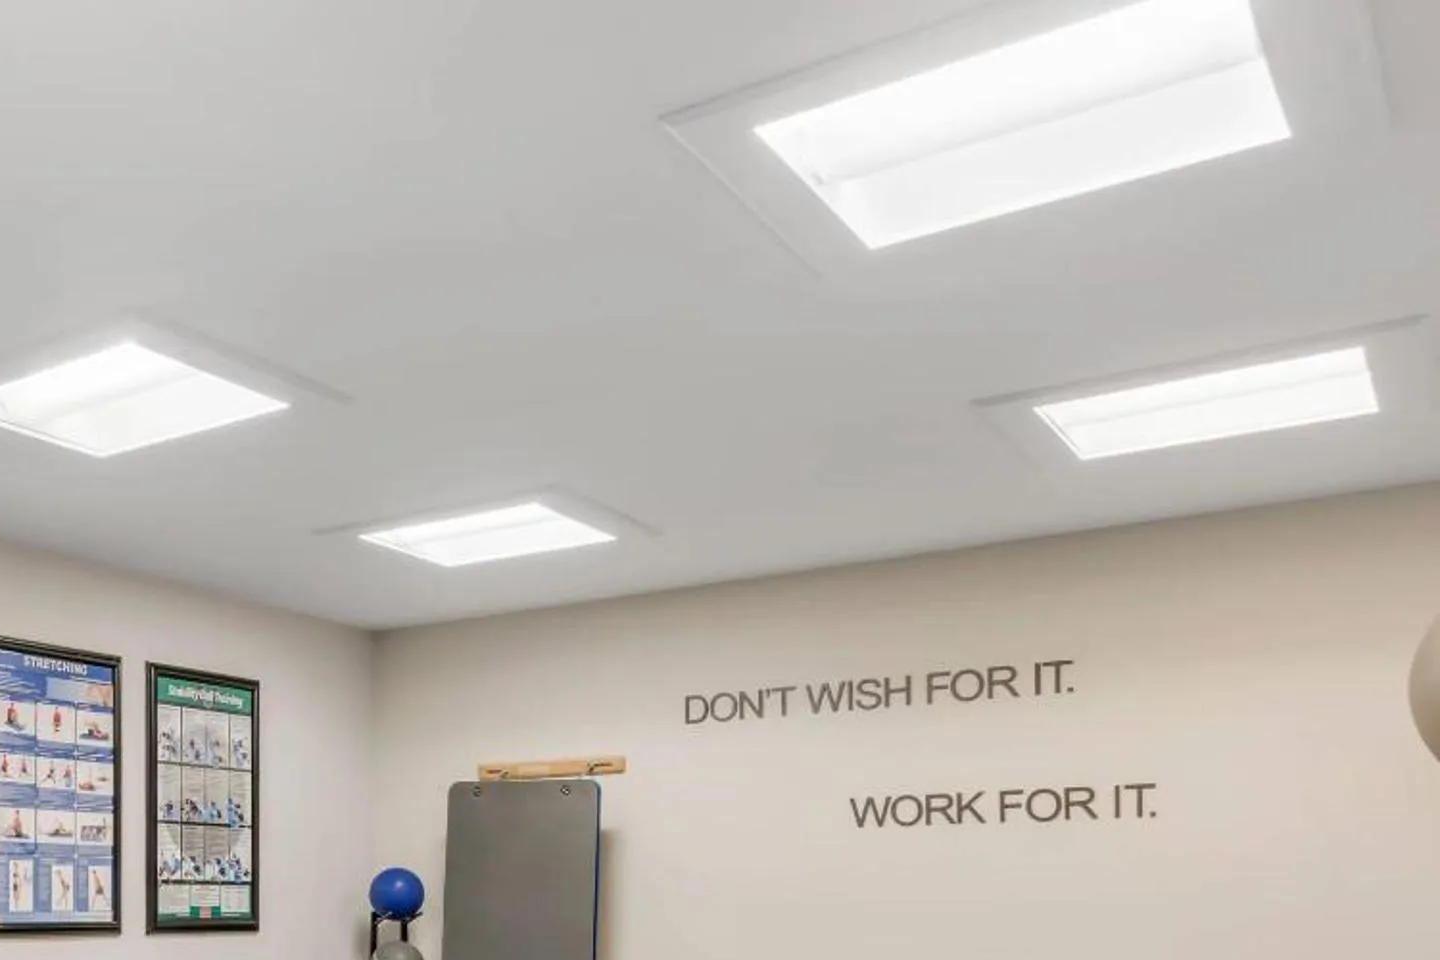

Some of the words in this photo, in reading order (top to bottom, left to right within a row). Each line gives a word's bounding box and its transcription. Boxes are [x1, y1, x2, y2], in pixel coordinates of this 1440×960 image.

[23, 655, 88, 675] STRETCHING
[685, 686, 797, 725] DON'T
[805, 675, 912, 715] WISH
[926, 665, 1020, 705] FOR
[1034, 660, 1075, 696] IT.
[850, 790, 987, 828] WORK
[999, 786, 1099, 823] FOR
[1114, 783, 1157, 819] IT.
